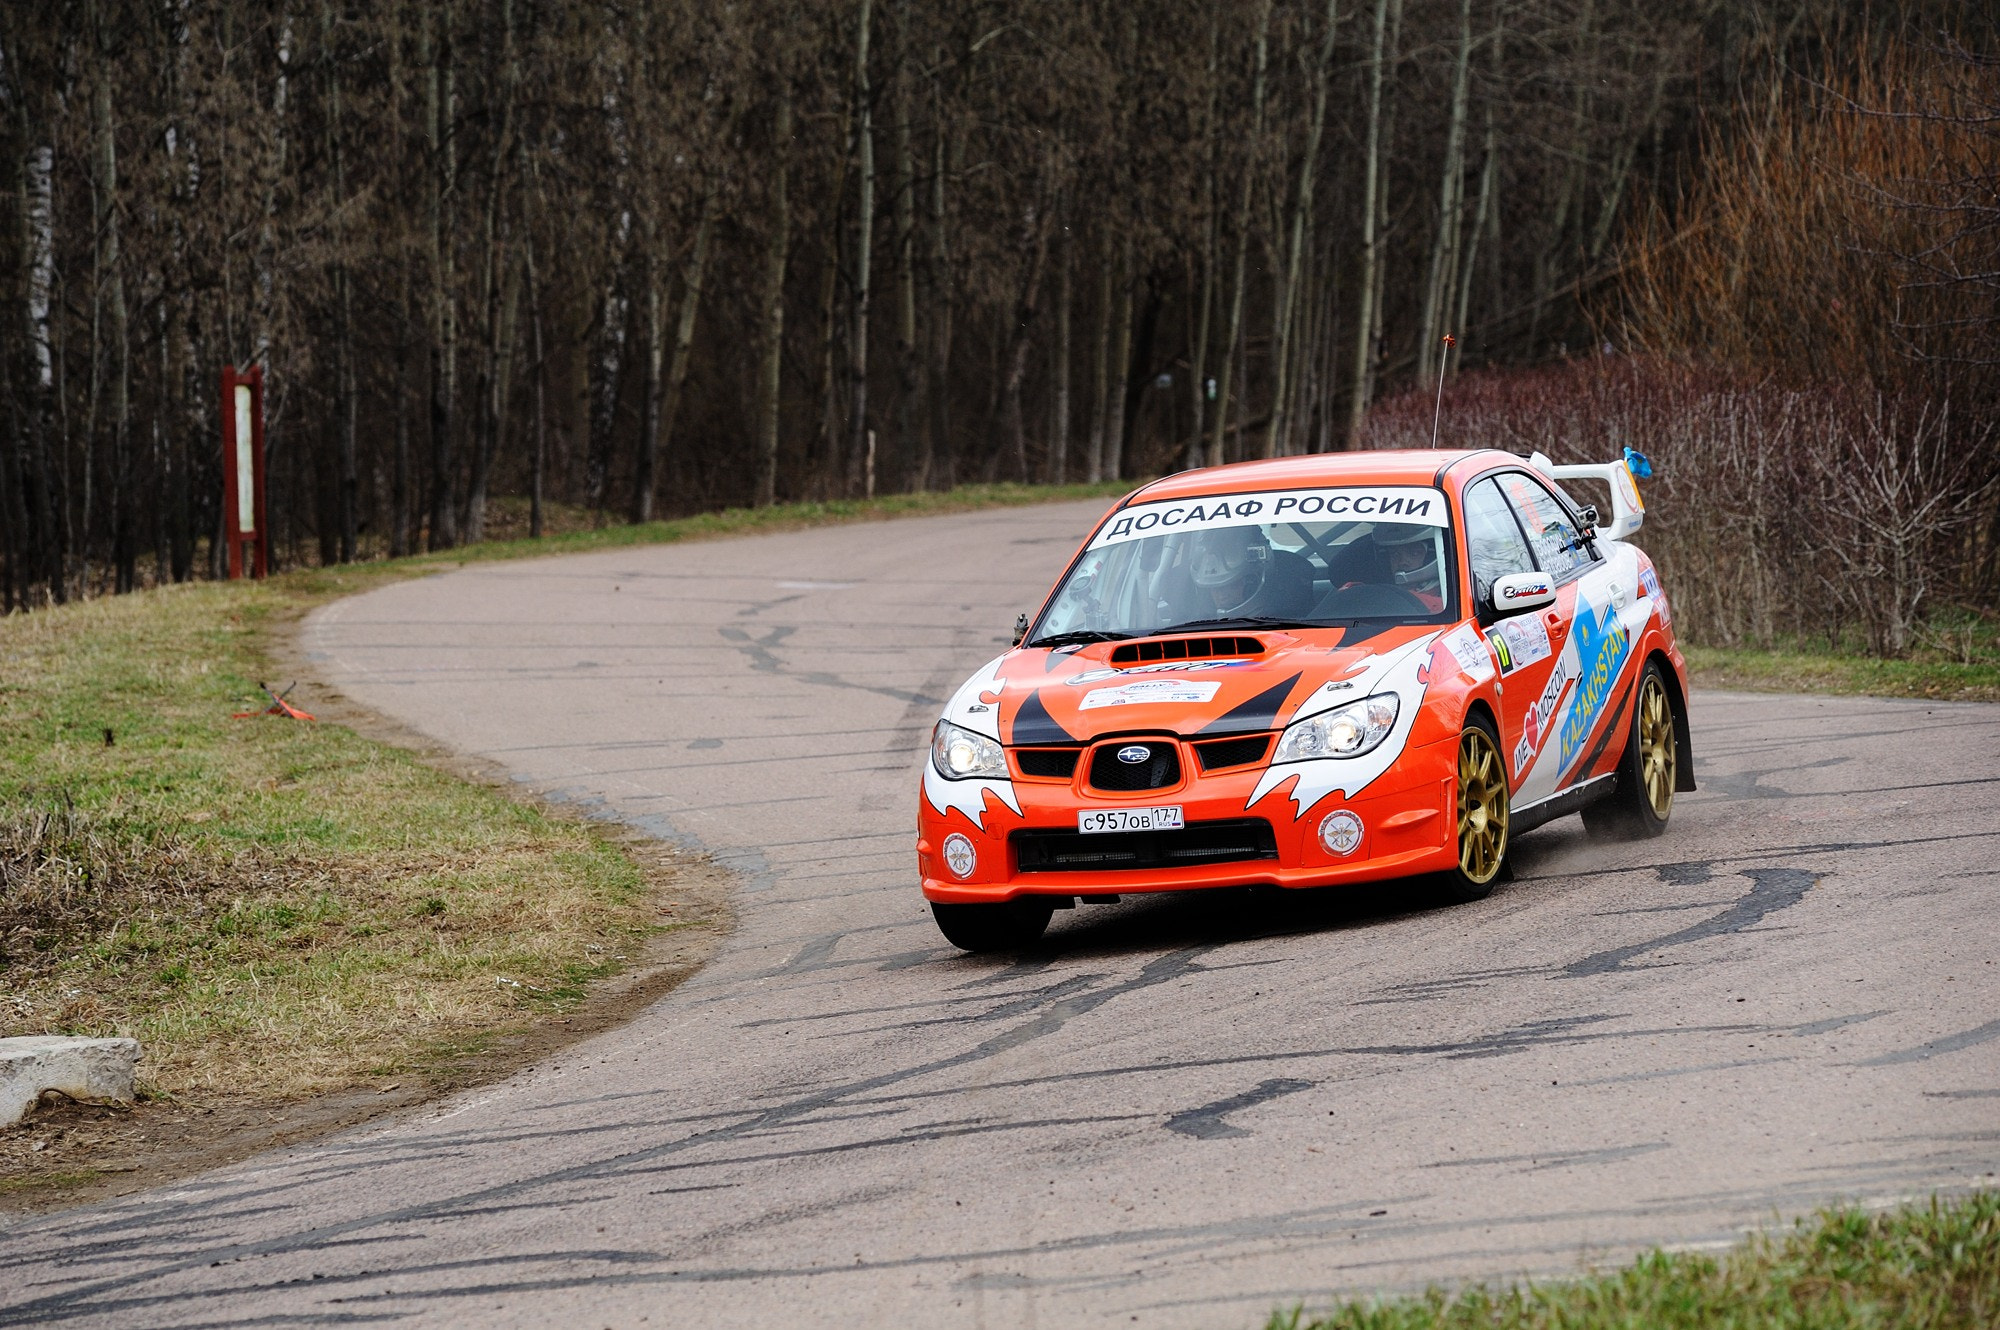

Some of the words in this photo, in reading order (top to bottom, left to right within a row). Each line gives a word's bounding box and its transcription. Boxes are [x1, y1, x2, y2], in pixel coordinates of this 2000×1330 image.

[1106, 500, 1263, 540] ДОСААФ
[1274, 496, 1431, 516] РОССИИ
[1515, 738, 1528, 771] WE
[1537, 656, 1566, 729] MOSCOW
[1561, 616, 1626, 764] KAZAKHSTAN
[1153, 808, 1178, 821] 177
